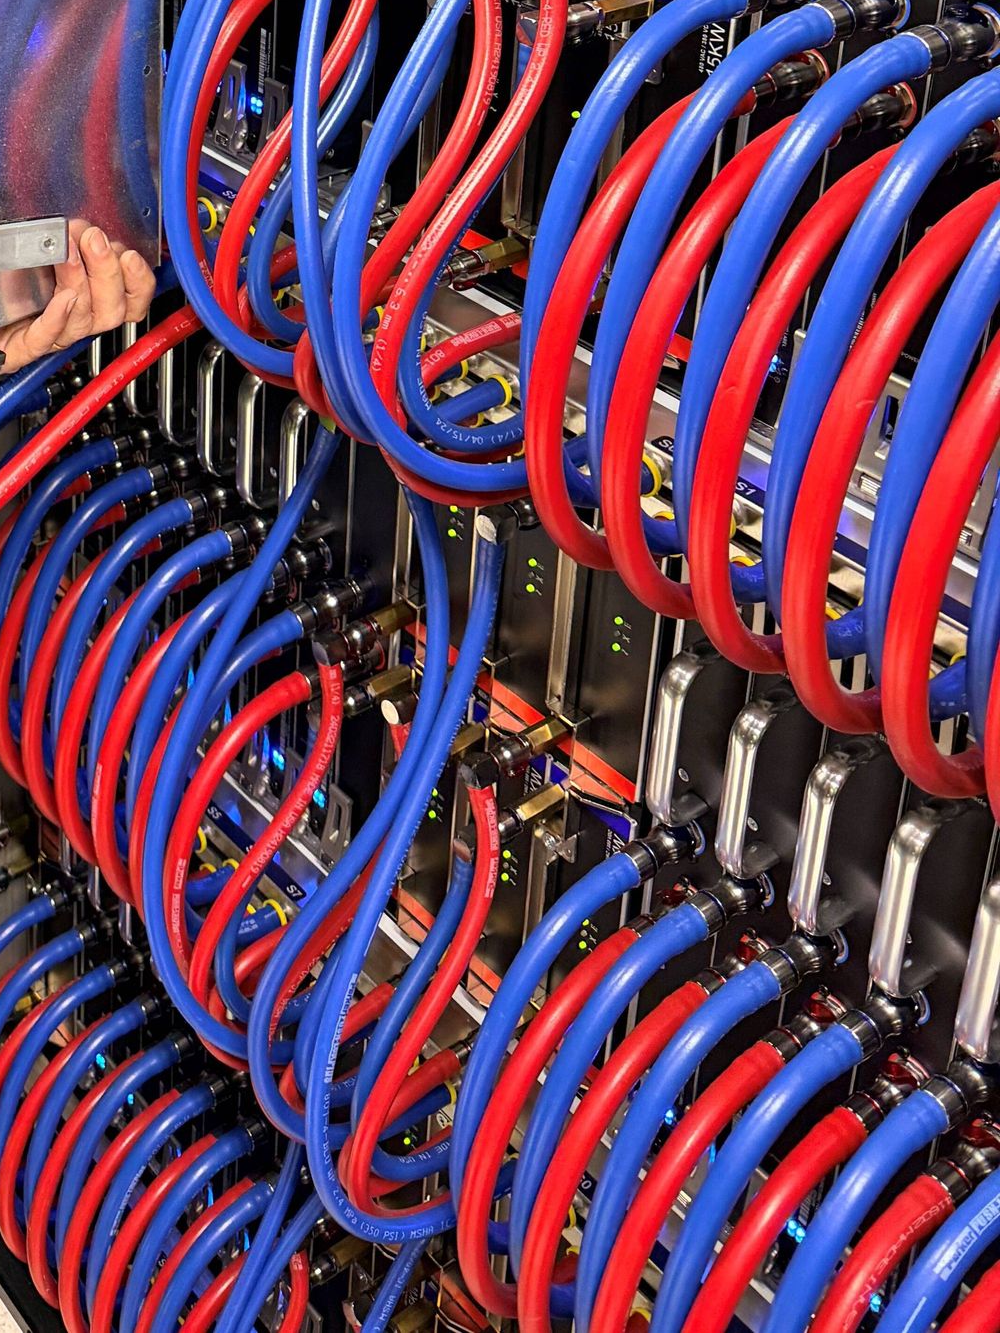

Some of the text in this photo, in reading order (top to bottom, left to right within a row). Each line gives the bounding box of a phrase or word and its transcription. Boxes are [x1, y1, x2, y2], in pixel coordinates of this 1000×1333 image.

[698, 47, 706, 62] VAC
[381, 313, 393, 330] mm
[371, 338, 388, 372] (1/4)
[434, 416, 485, 445] 04/15/24
[735, 481, 757, 496] S1
[207, 806, 223, 820] S5
[286, 883, 304, 899] S7
[344, 1207, 358, 1225] MPa
[359, 1221, 380, 1239] (350
[382, 1228, 406, 1242] PSI)
[409, 1224, 435, 1239] MSHA
